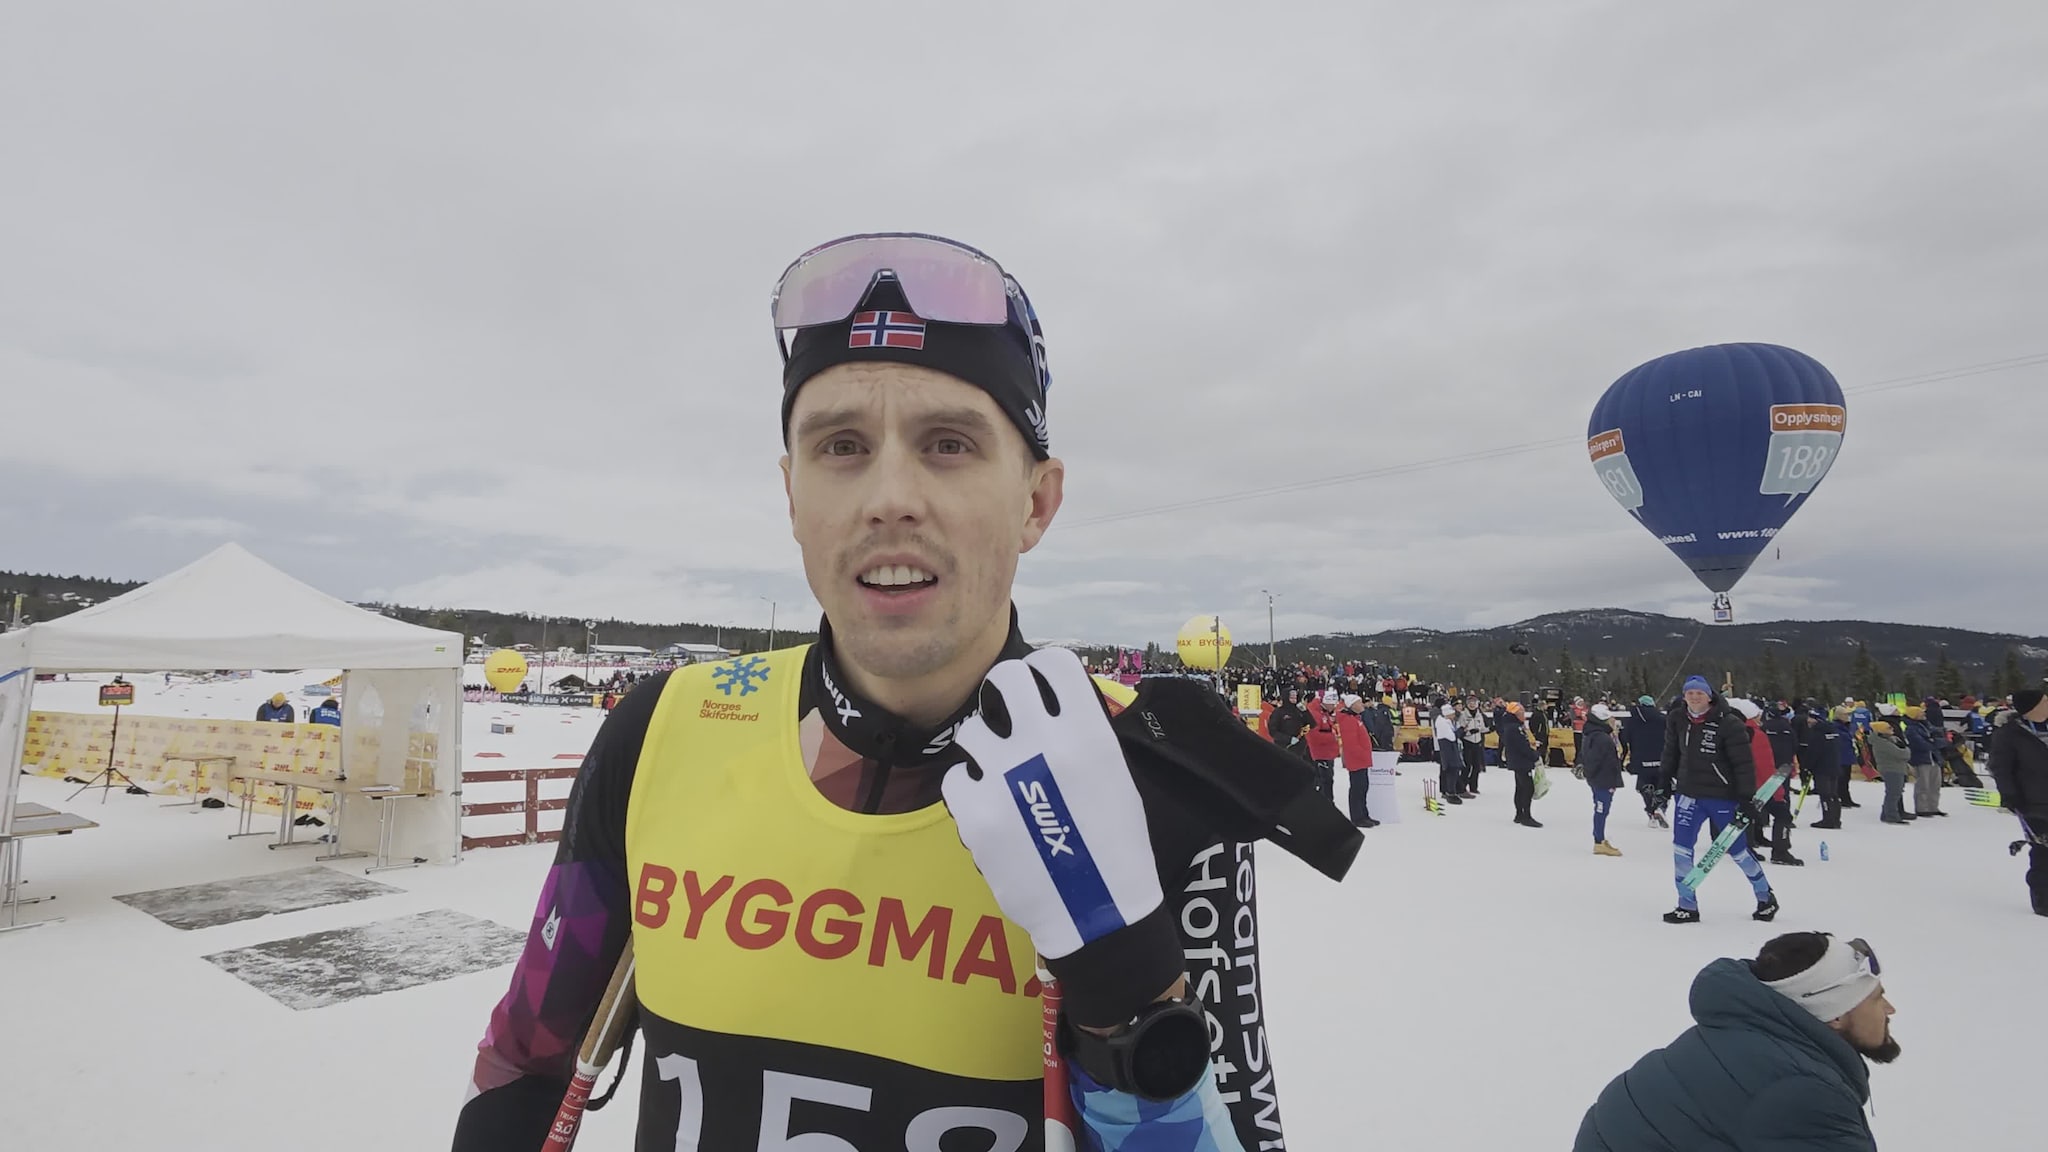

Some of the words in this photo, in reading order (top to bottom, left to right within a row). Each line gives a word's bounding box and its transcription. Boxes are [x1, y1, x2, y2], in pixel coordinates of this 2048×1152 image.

[703, 699, 742, 712] Norges
[699, 708, 759, 722] Skiforbund
[1017, 780, 1074, 858] Swix
